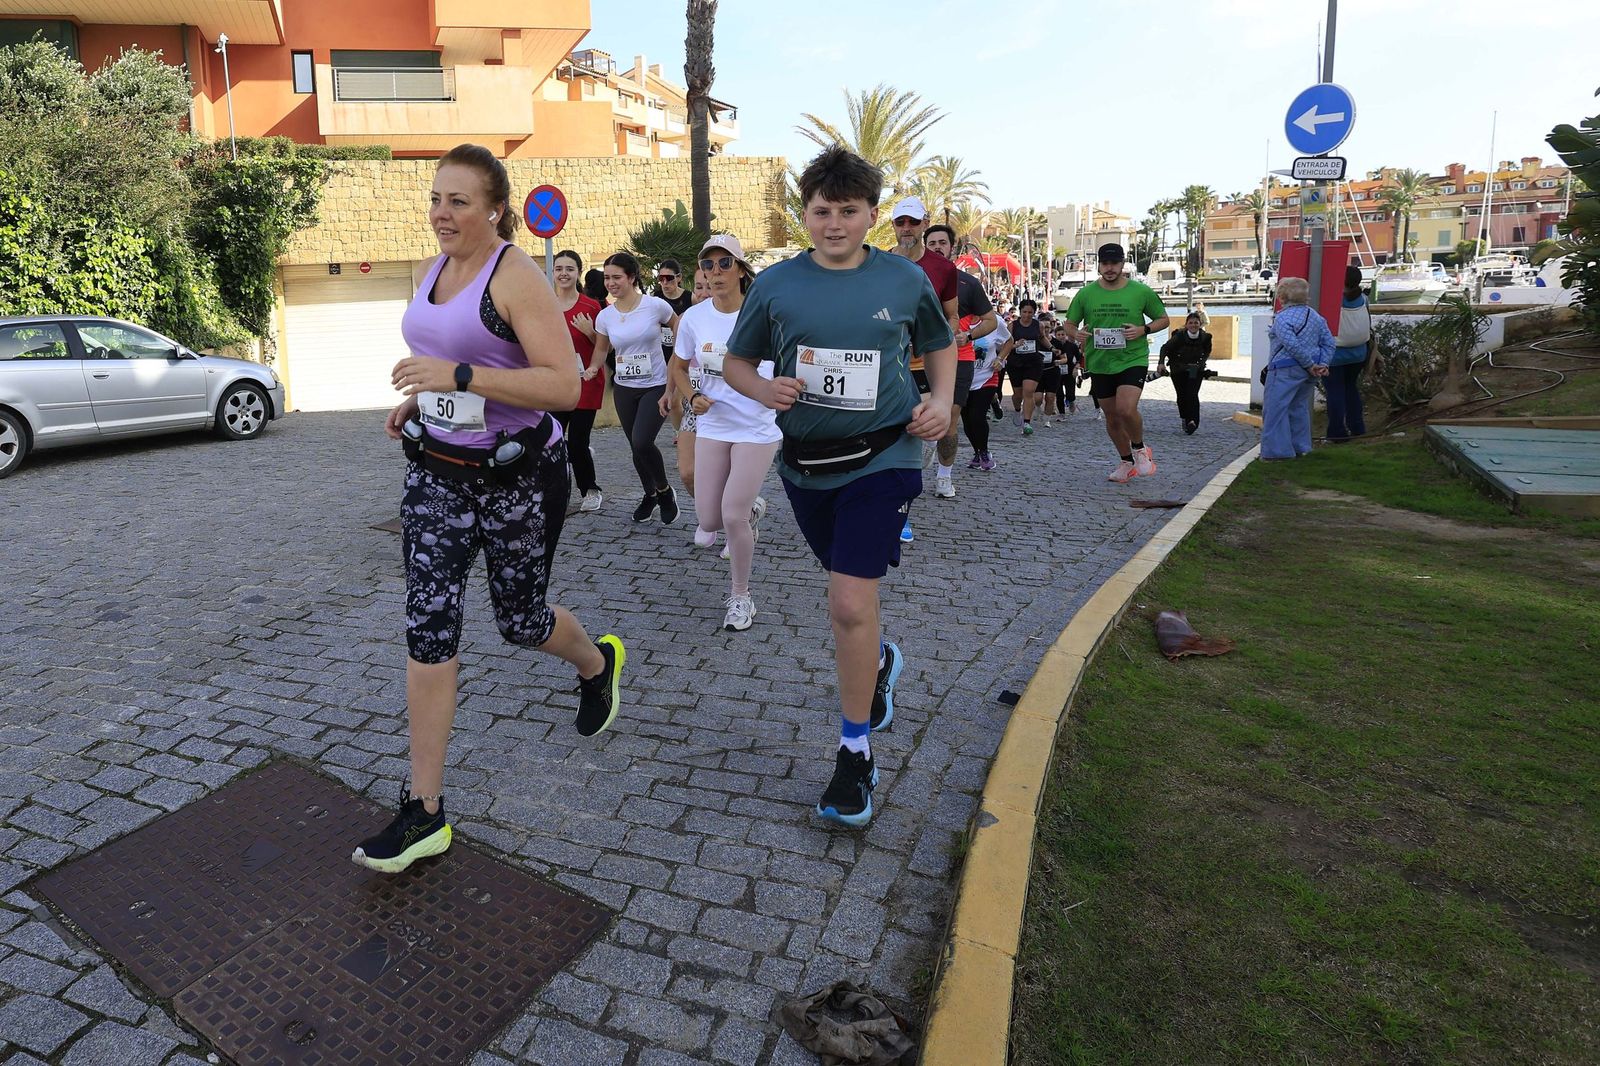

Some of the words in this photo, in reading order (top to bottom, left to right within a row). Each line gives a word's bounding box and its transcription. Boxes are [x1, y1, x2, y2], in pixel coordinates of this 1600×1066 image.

[844, 353, 873, 363] RUN
[625, 365, 641, 375] 216
[823, 375, 845, 396] 81
[437, 397, 454, 419] 50
[388, 919, 456, 959] endesa
